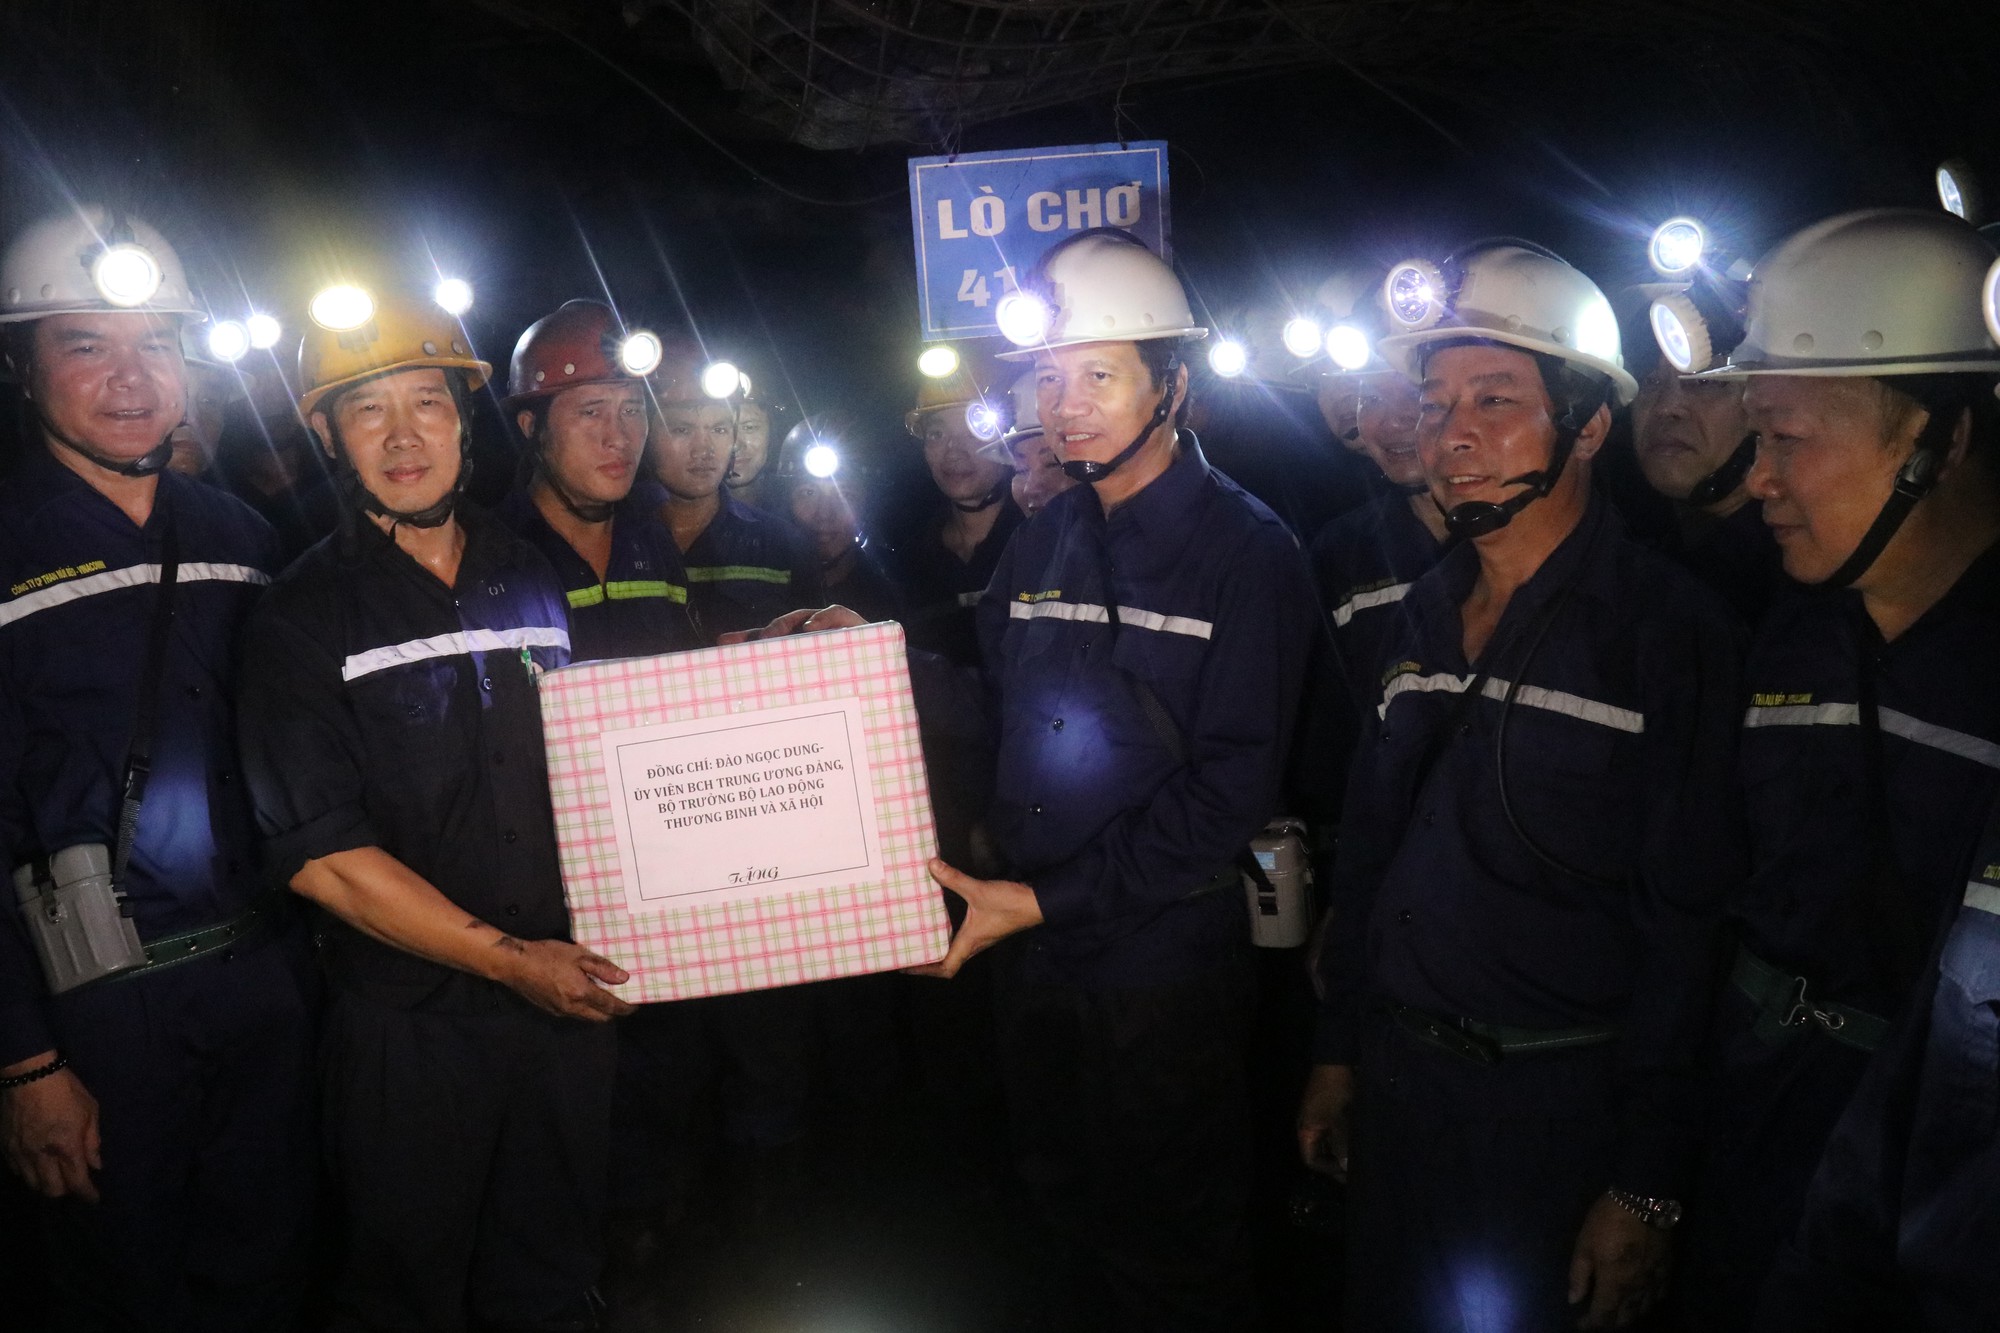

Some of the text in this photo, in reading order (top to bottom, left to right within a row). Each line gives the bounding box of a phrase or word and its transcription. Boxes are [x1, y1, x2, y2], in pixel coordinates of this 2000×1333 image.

[937, 185, 1006, 240] LÒ
[634, 759, 844, 801] ỦY VIÊN BCH TRUNG ƯƠNG ĐẢNG,
[647, 764, 684, 779] ĐỒNG
[686, 757, 713, 773] CHÍ:
[716, 753, 743, 769] ĐÀO
[745, 749, 781, 764] NGỌC
[658, 778, 825, 814] BỘ TRƯỞNG BỘ LAO ĐỘNG
[664, 793, 824, 829] THƯƠNG BINH VÀ XÃ HỘI
